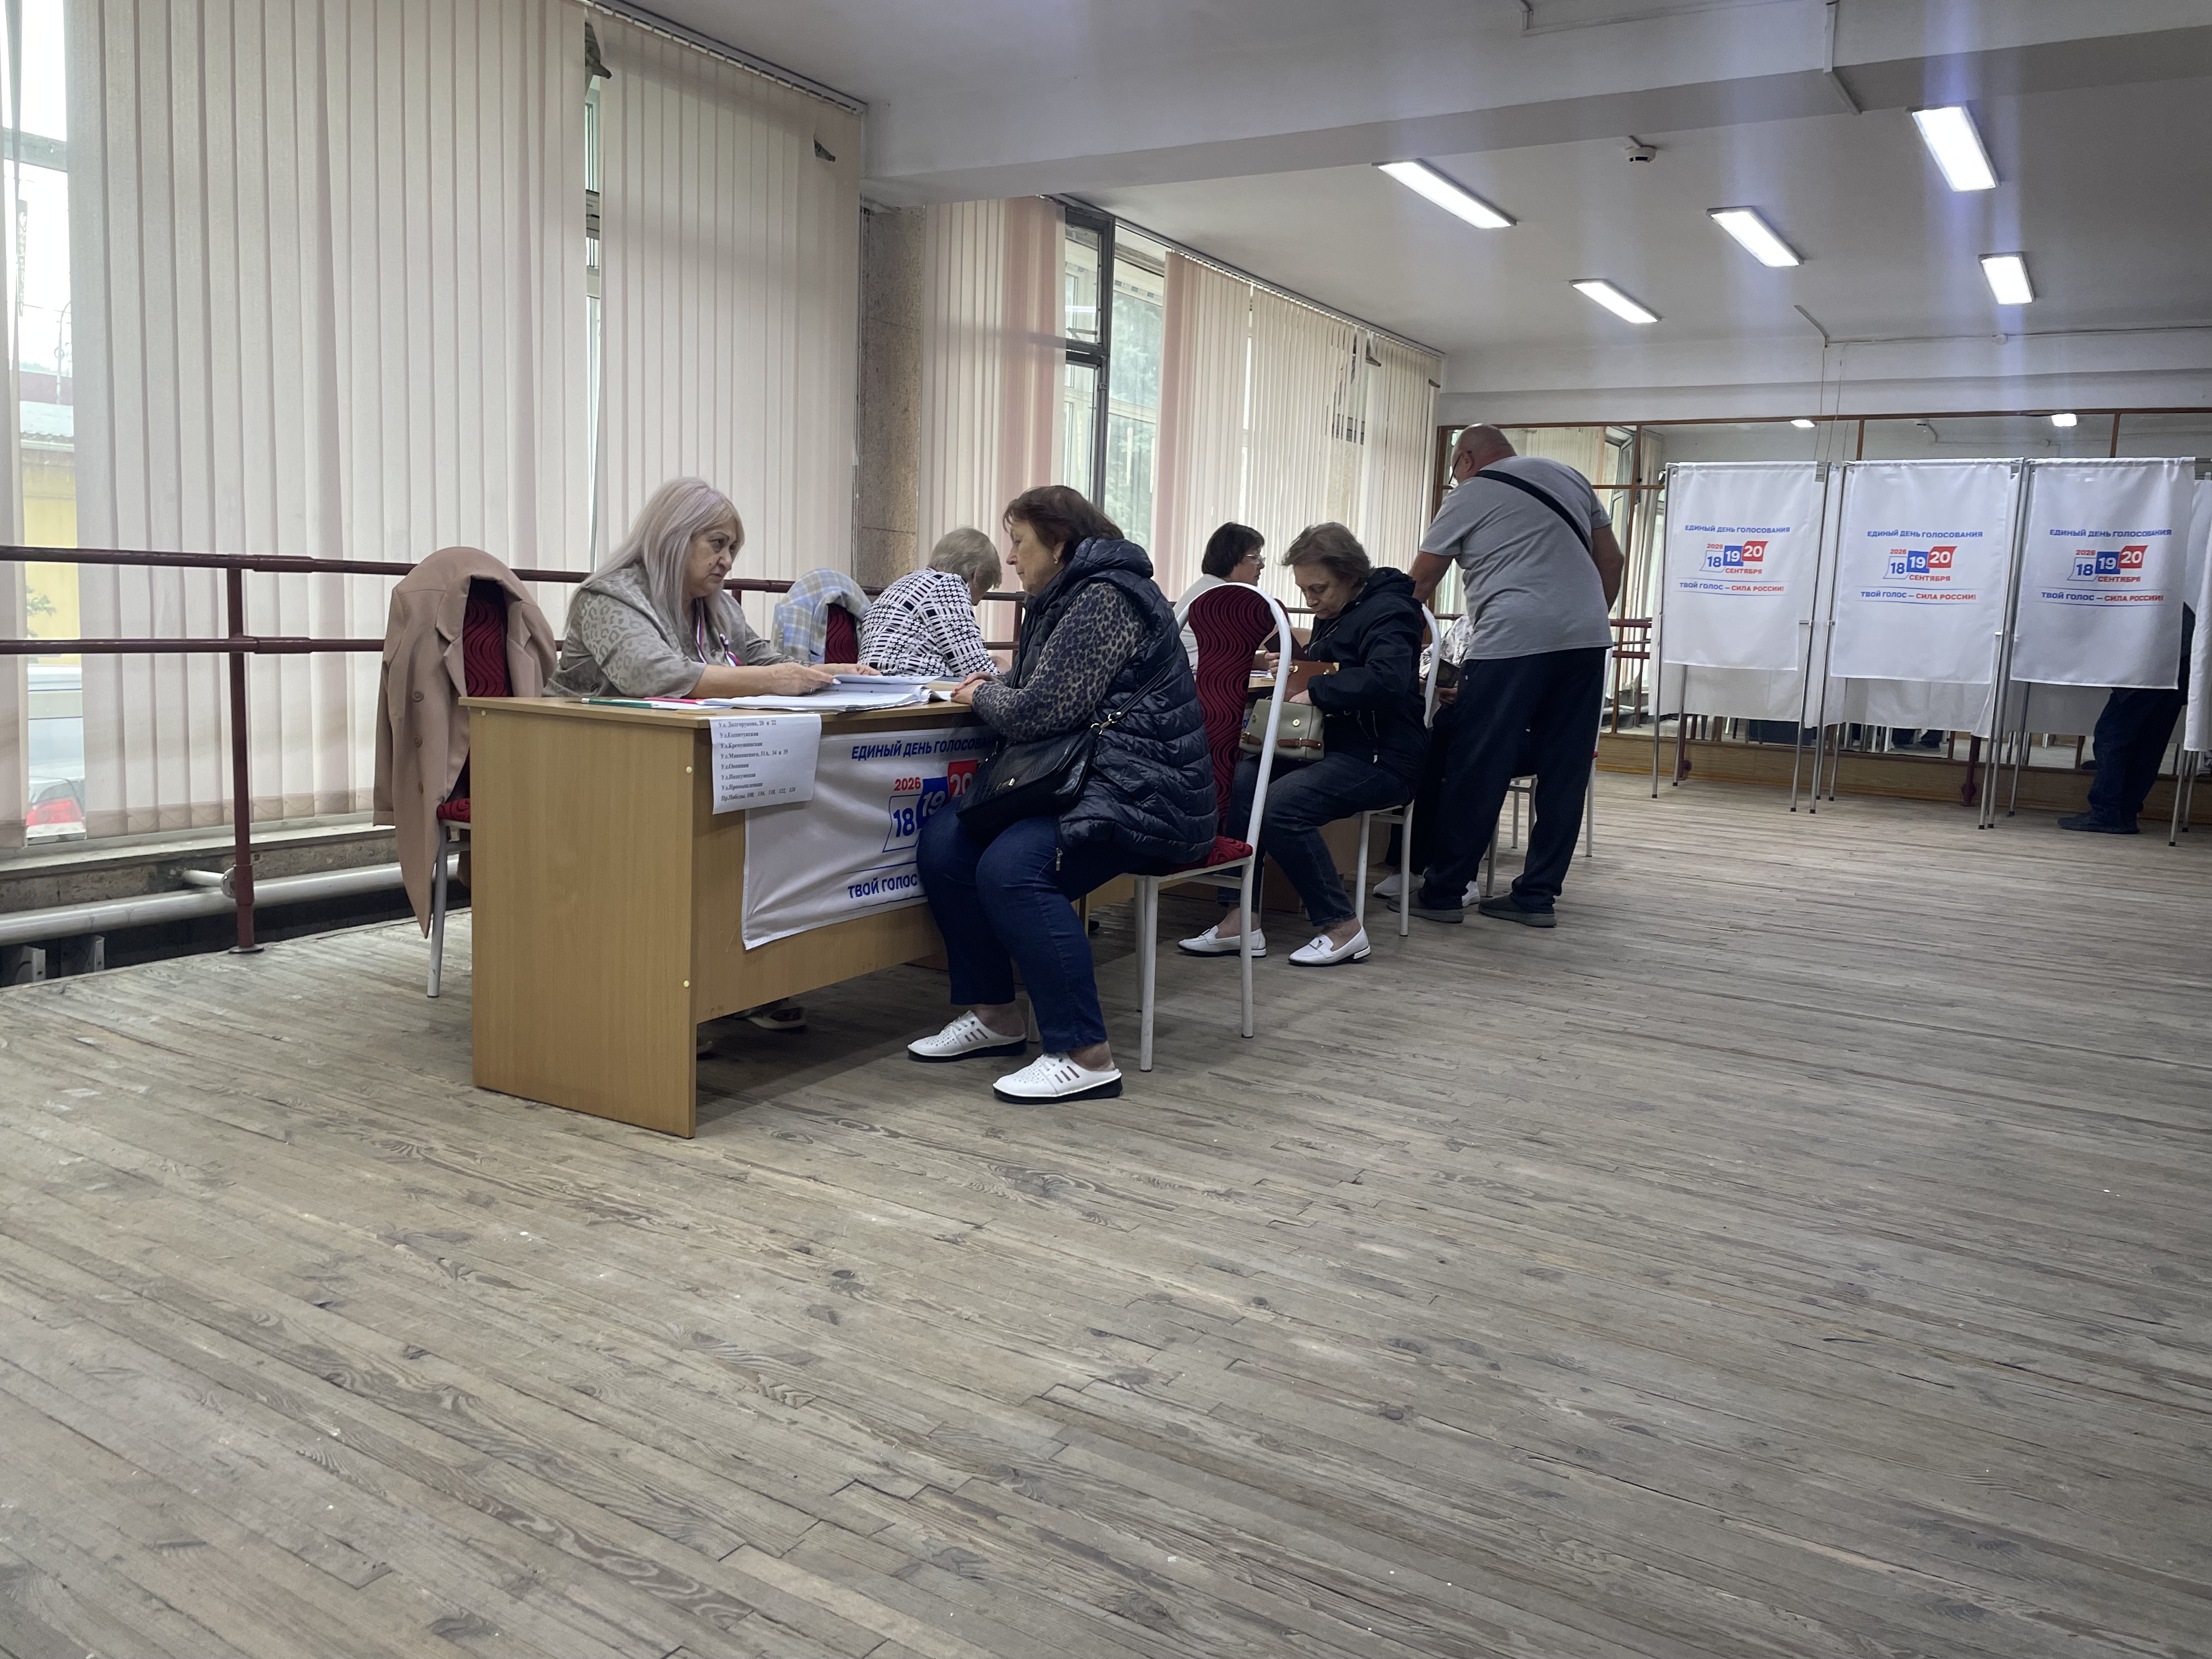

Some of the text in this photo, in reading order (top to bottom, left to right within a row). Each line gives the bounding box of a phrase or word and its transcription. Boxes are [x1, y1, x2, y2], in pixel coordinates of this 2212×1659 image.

[1707, 545, 1763, 568] 18 19 20
[1891, 551, 1950, 574] 18 19 20
[2076, 551, 2142, 576] 18 19 20
[2041, 591, 2064, 600] ТВОЙ
[2066, 593, 2094, 601] ГОЛОС
[851, 740, 902, 761] ЕДИНЫЙ
[903, 742, 932, 758] ДЕНЬ
[894, 777, 921, 791] 2026
[893, 808, 915, 838] 18
[922, 791, 946, 817] 19
[848, 873, 917, 899] ТВОЙ ГОЛОС
